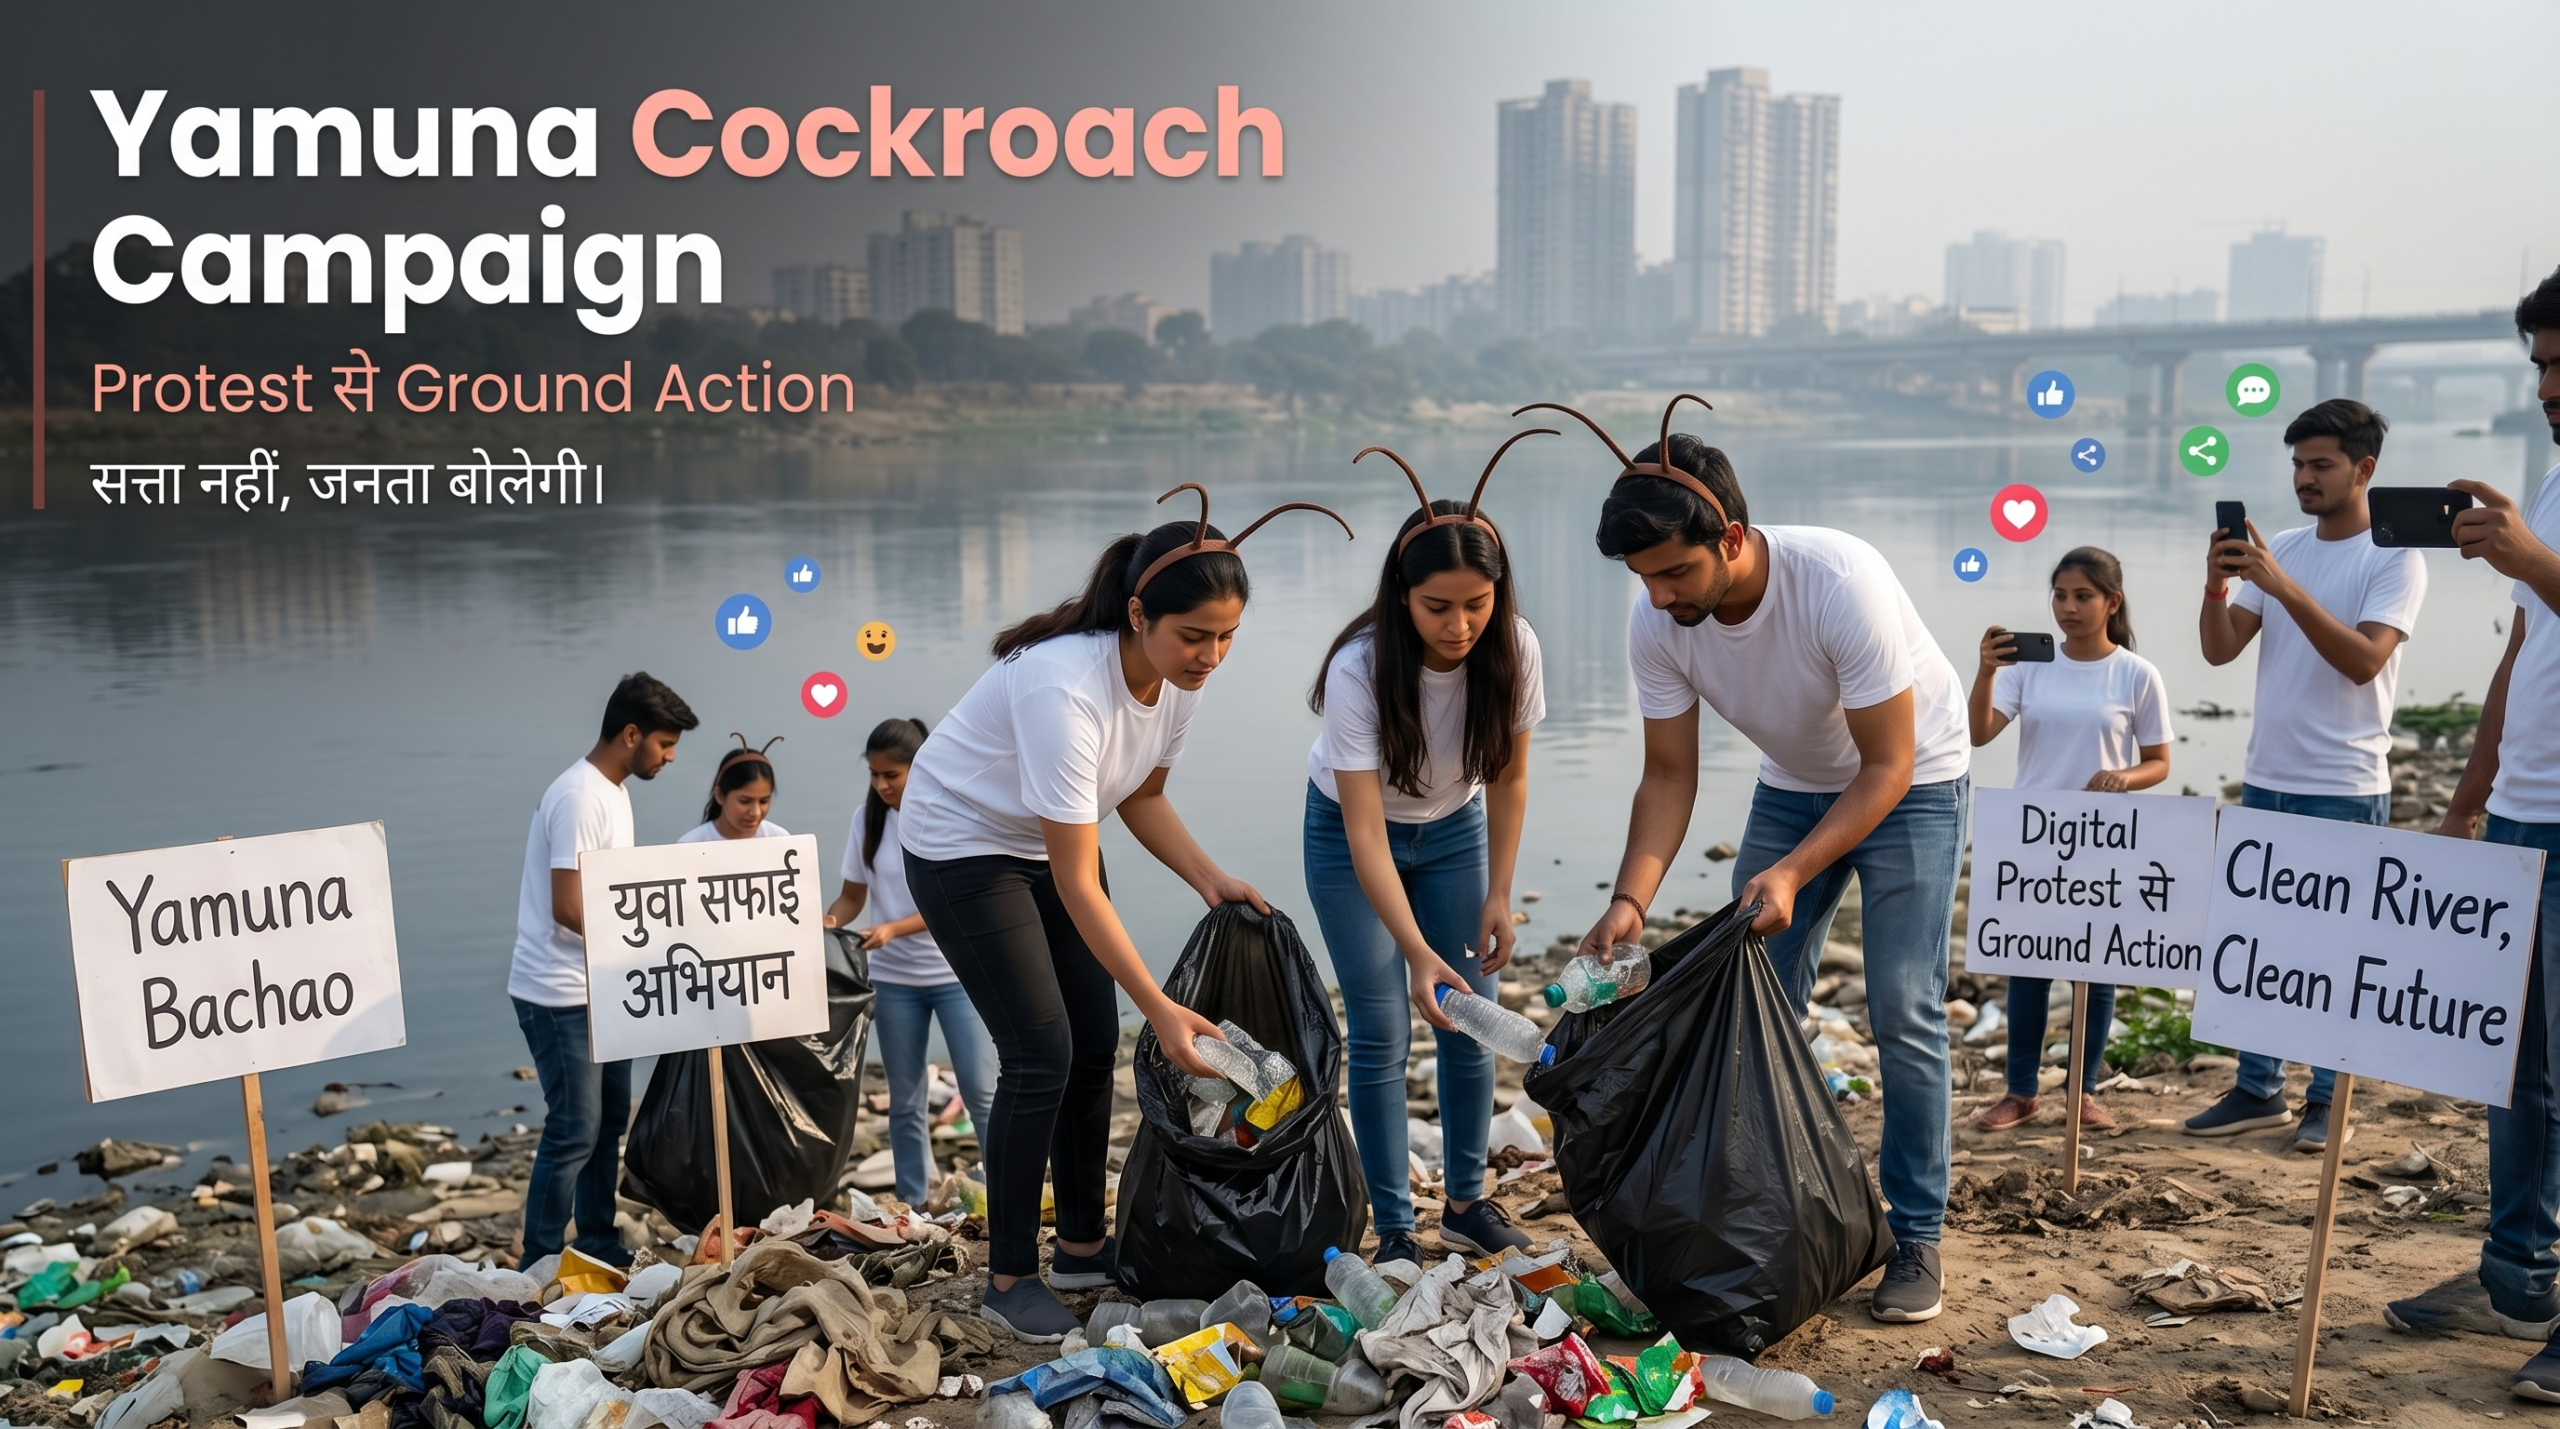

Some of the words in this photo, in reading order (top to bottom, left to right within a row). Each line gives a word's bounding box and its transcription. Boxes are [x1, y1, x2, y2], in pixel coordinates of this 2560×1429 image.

[2021, 804, 2138, 861] Digital
[105, 874, 353, 954] Yamuna
[608, 878, 687, 948] युवा
[697, 849, 800, 925] सफाई
[1996, 861, 2122, 908] Protest
[2138, 861, 2176, 912] से
[2226, 839, 2351, 914] Clean
[2371, 856, 2511, 951] River,
[622, 942, 795, 1018] अभियान
[1978, 918, 2092, 963] Ground
[2103, 923, 2202, 971] Action
[142, 959, 354, 1049] Bachao
[2212, 934, 2332, 1012] Clean
[2349, 955, 2508, 1046] Future
